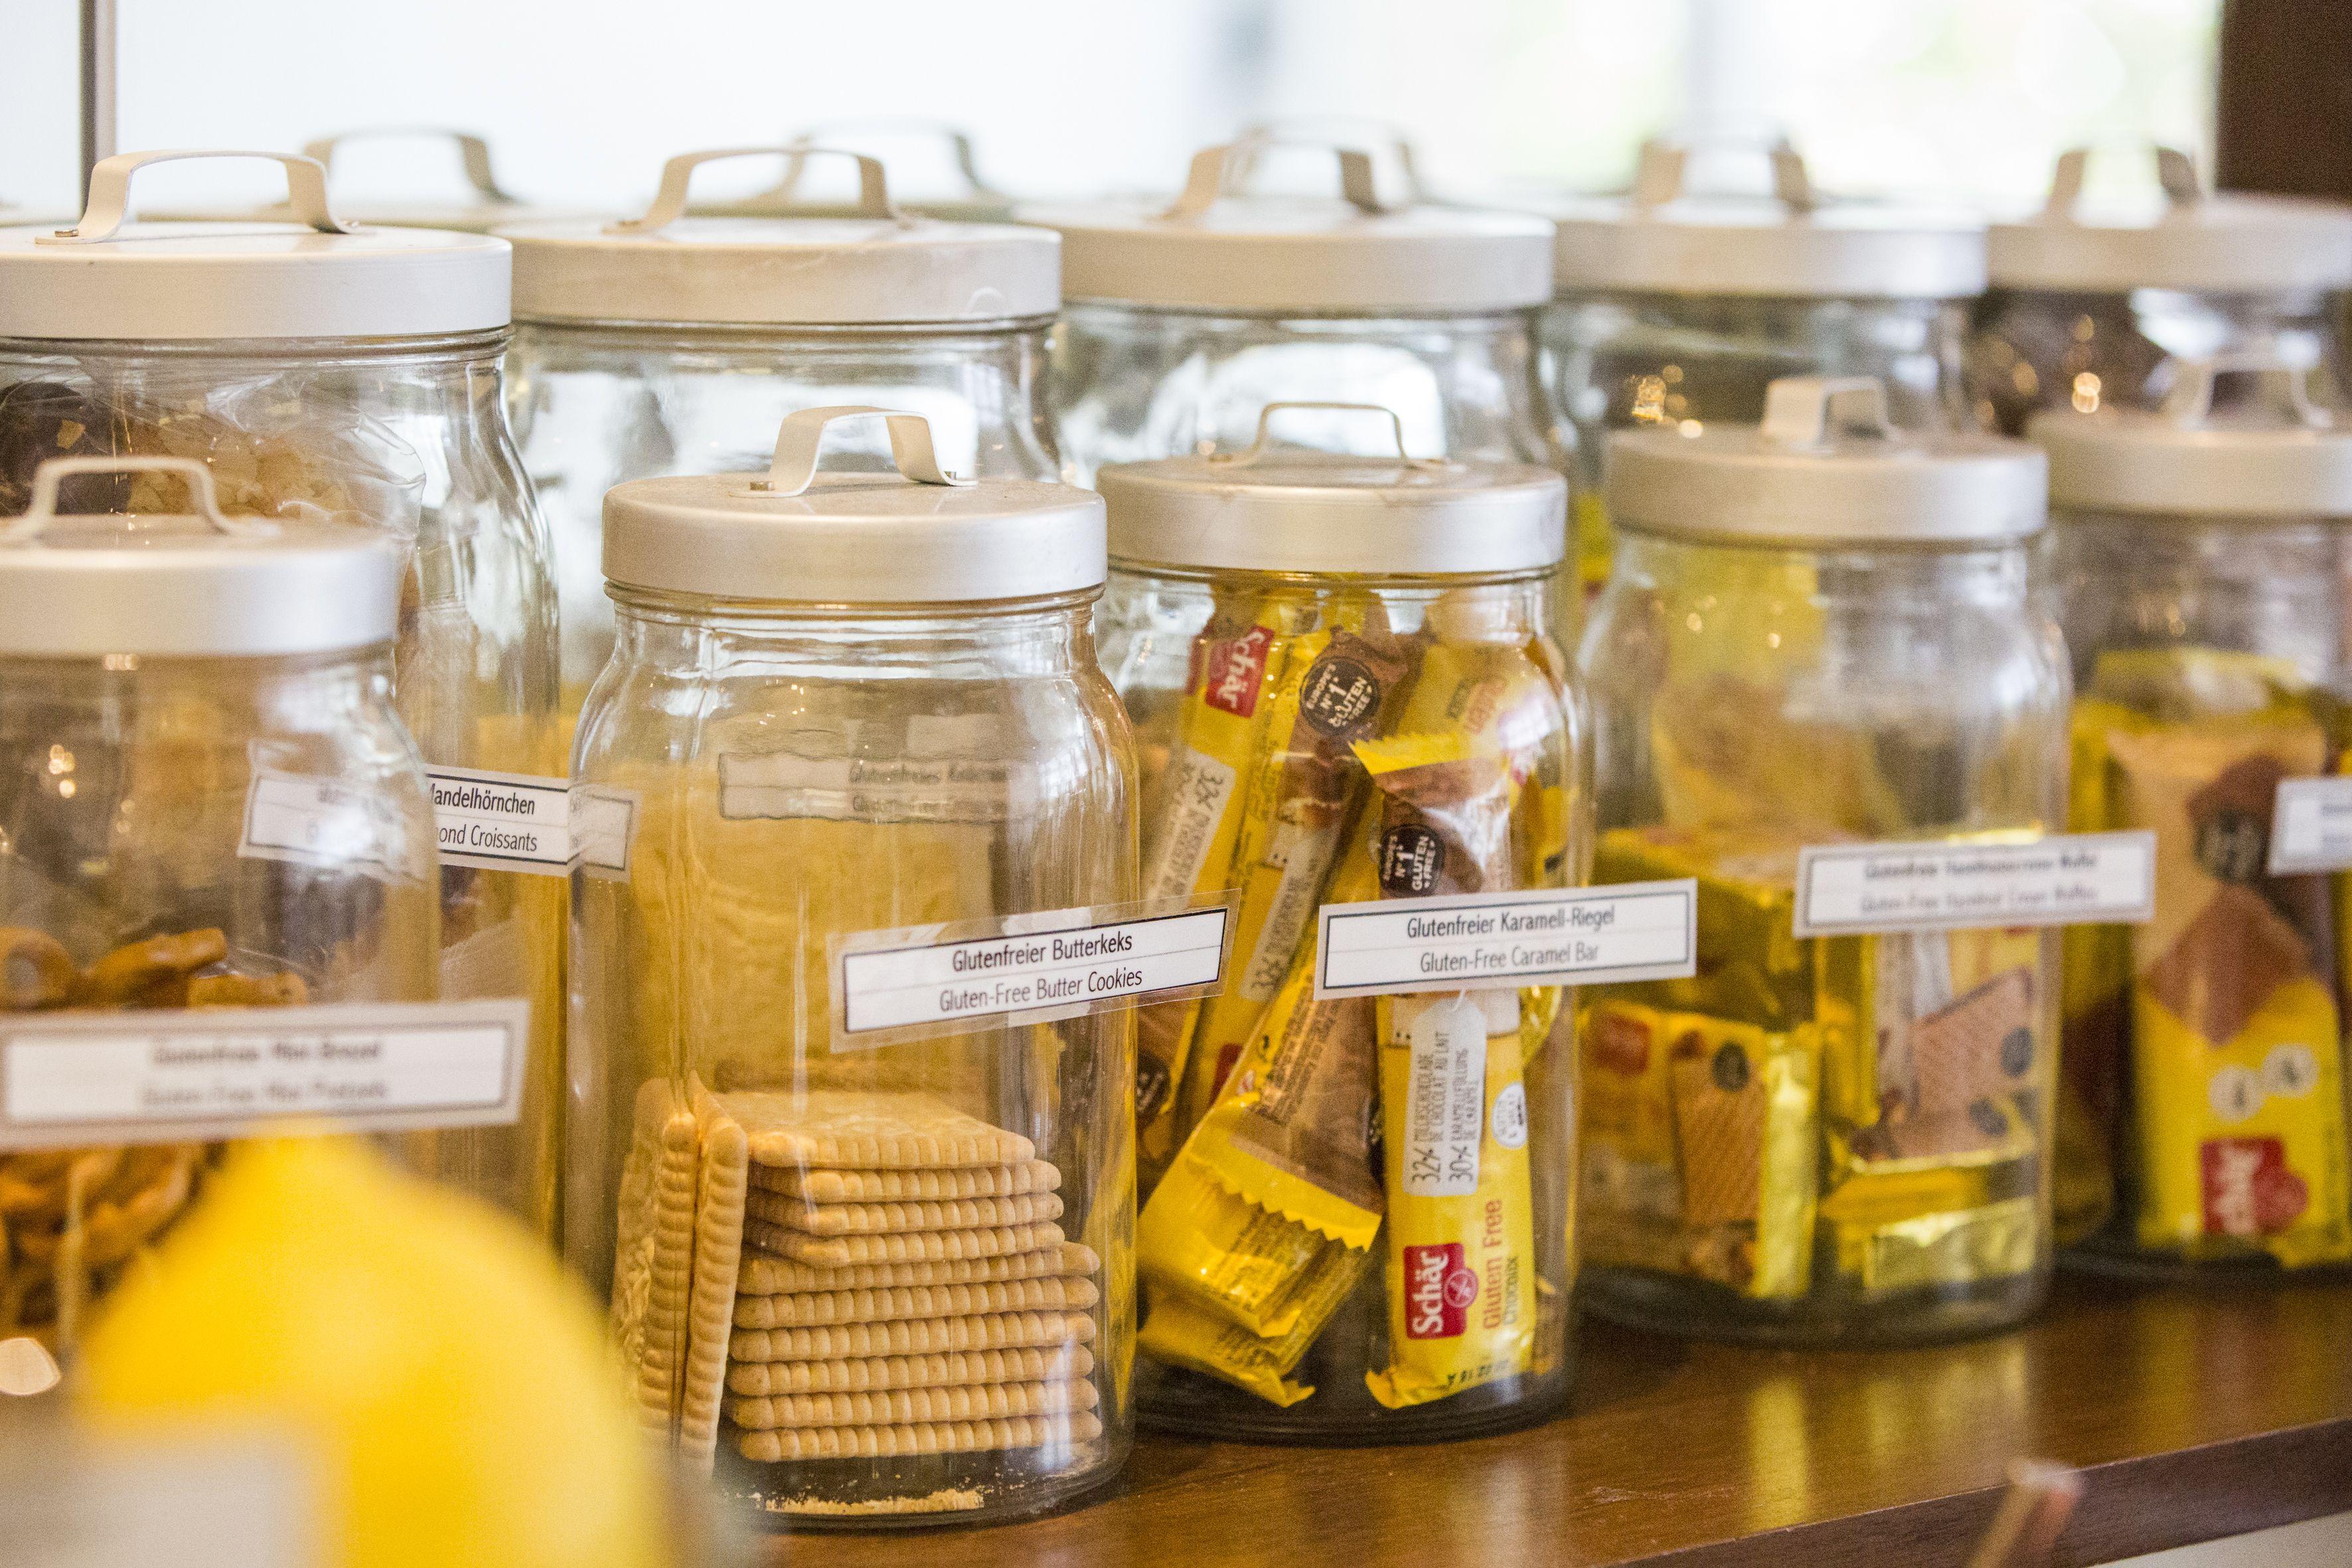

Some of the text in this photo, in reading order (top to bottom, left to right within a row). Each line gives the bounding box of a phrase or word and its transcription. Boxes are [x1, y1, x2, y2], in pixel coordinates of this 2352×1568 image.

[1328, 676, 1368, 728] GLUTEN
[1348, 694, 1371, 720] FREE
[471, 825, 537, 851] Croissants
[1412, 836, 1429, 890] GLUTEN
[1423, 850, 1436, 880] FREE
[1407, 906, 1615, 938] Glutenfreier Karamell-Riegel
[953, 931, 1133, 972] Glutenfreier Butterkeks
[1421, 941, 1599, 972] Gluten-Free Caramel Bar
[939, 967, 1142, 1012] Gluten-Free Butter Cookies
[1413, 1148, 1441, 1182] 32%
[1449, 1146, 1473, 1182] 30%
[1482, 1200, 1502, 1330] Gluten Free
[1413, 1251, 1449, 1334] Schär
